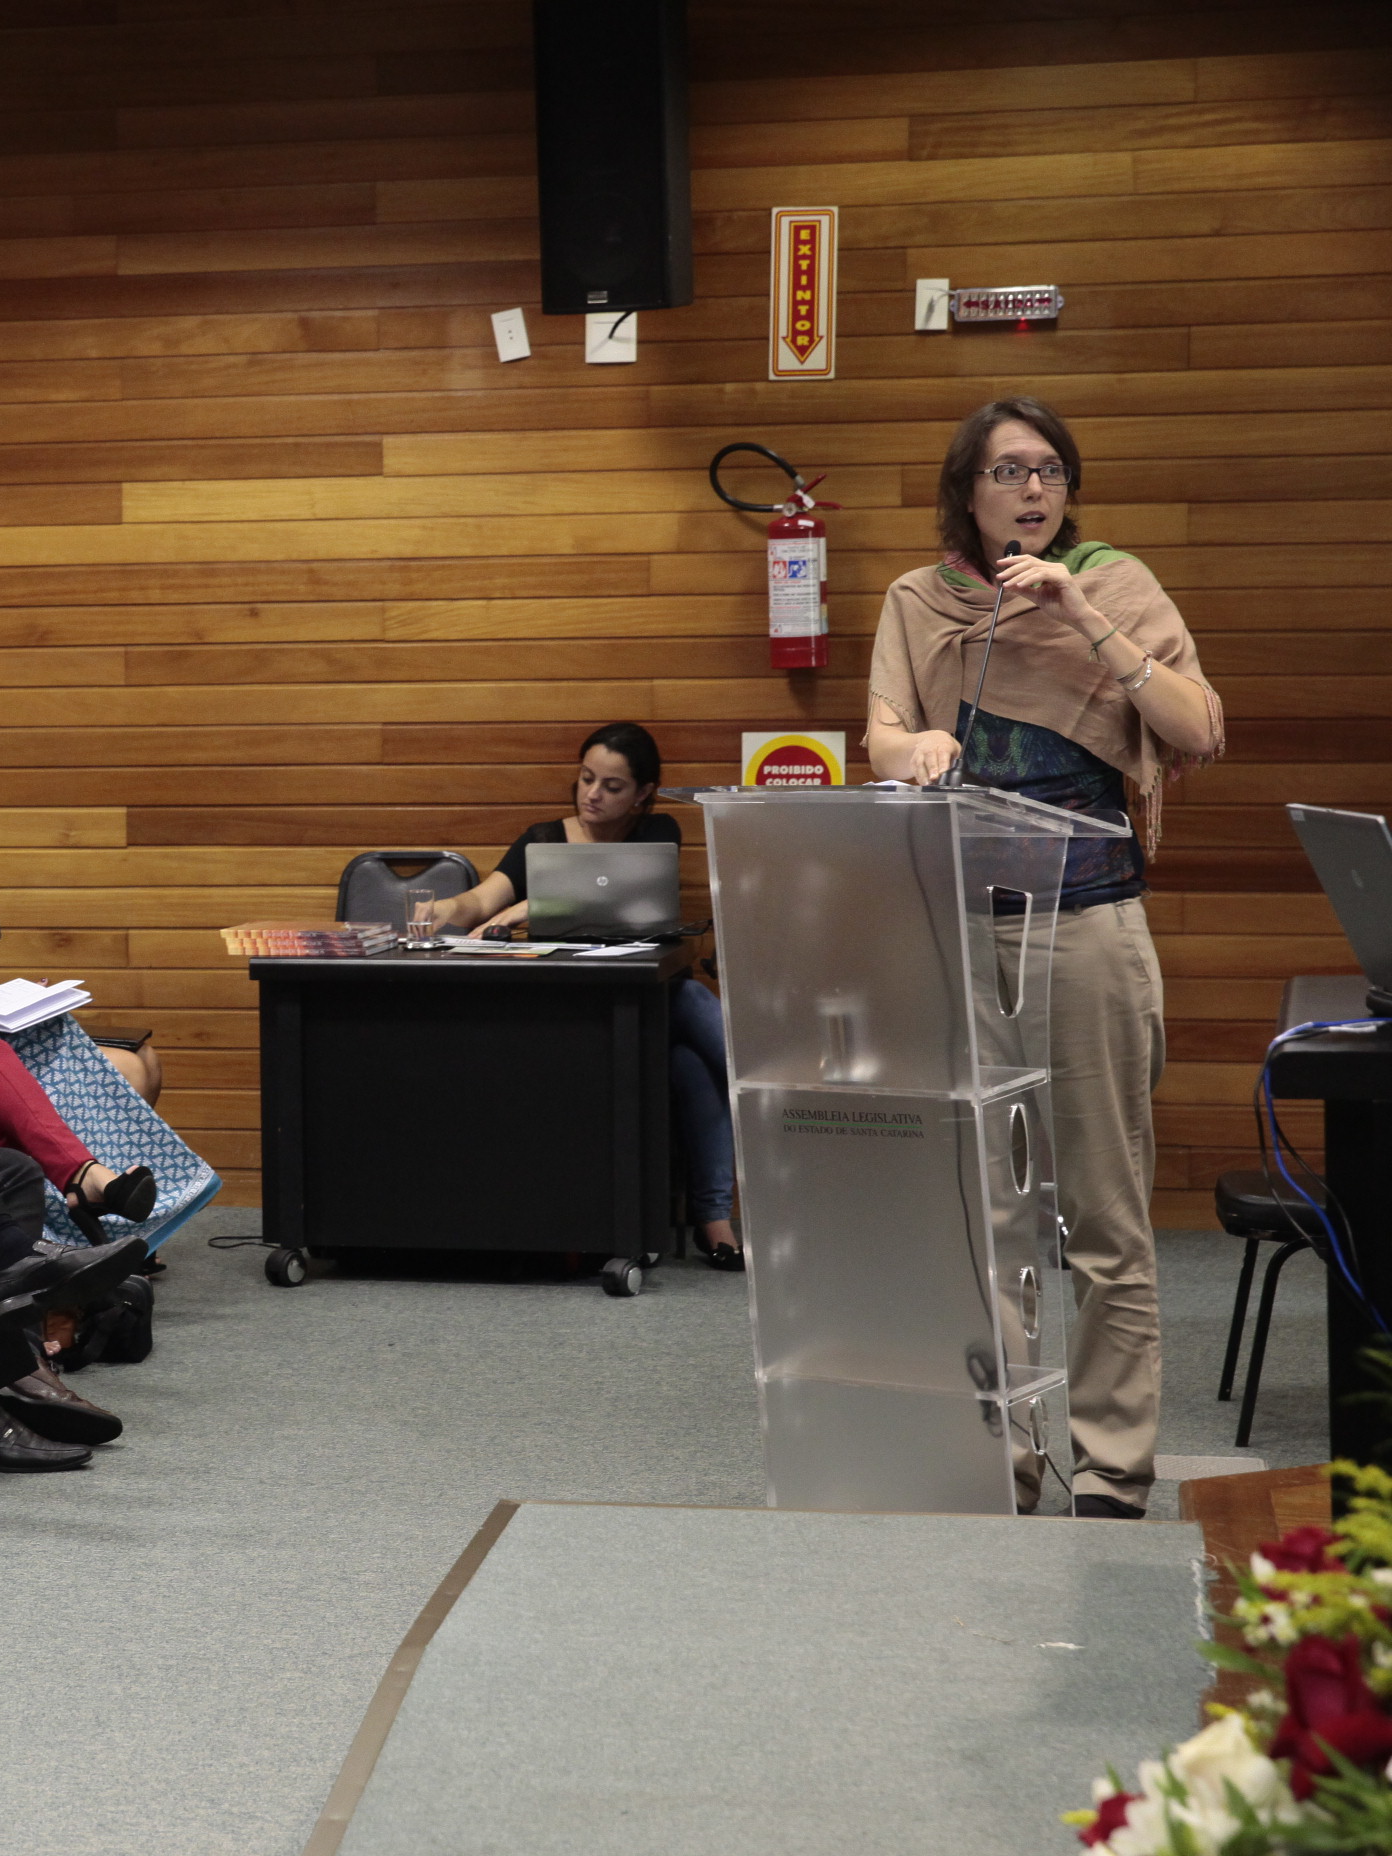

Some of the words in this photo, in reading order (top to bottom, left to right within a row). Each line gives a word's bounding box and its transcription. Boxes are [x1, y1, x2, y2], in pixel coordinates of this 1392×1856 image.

[795, 229, 813, 346] EXTINTOR
[763, 765, 824, 775] PROIBIDO
[765, 778, 822, 786] COLOCAR
[783, 1108, 849, 1121] ASSEMBLEIA
[852, 1111, 923, 1125] LEGISLATIVA
[783, 1124, 796, 1133] DO
[798, 1125, 833, 1135] ESTADO
[836, 1127, 849, 1135] DE
[850, 1127, 878, 1137] SANTA
[880, 1128, 924, 1139] CATARINA
